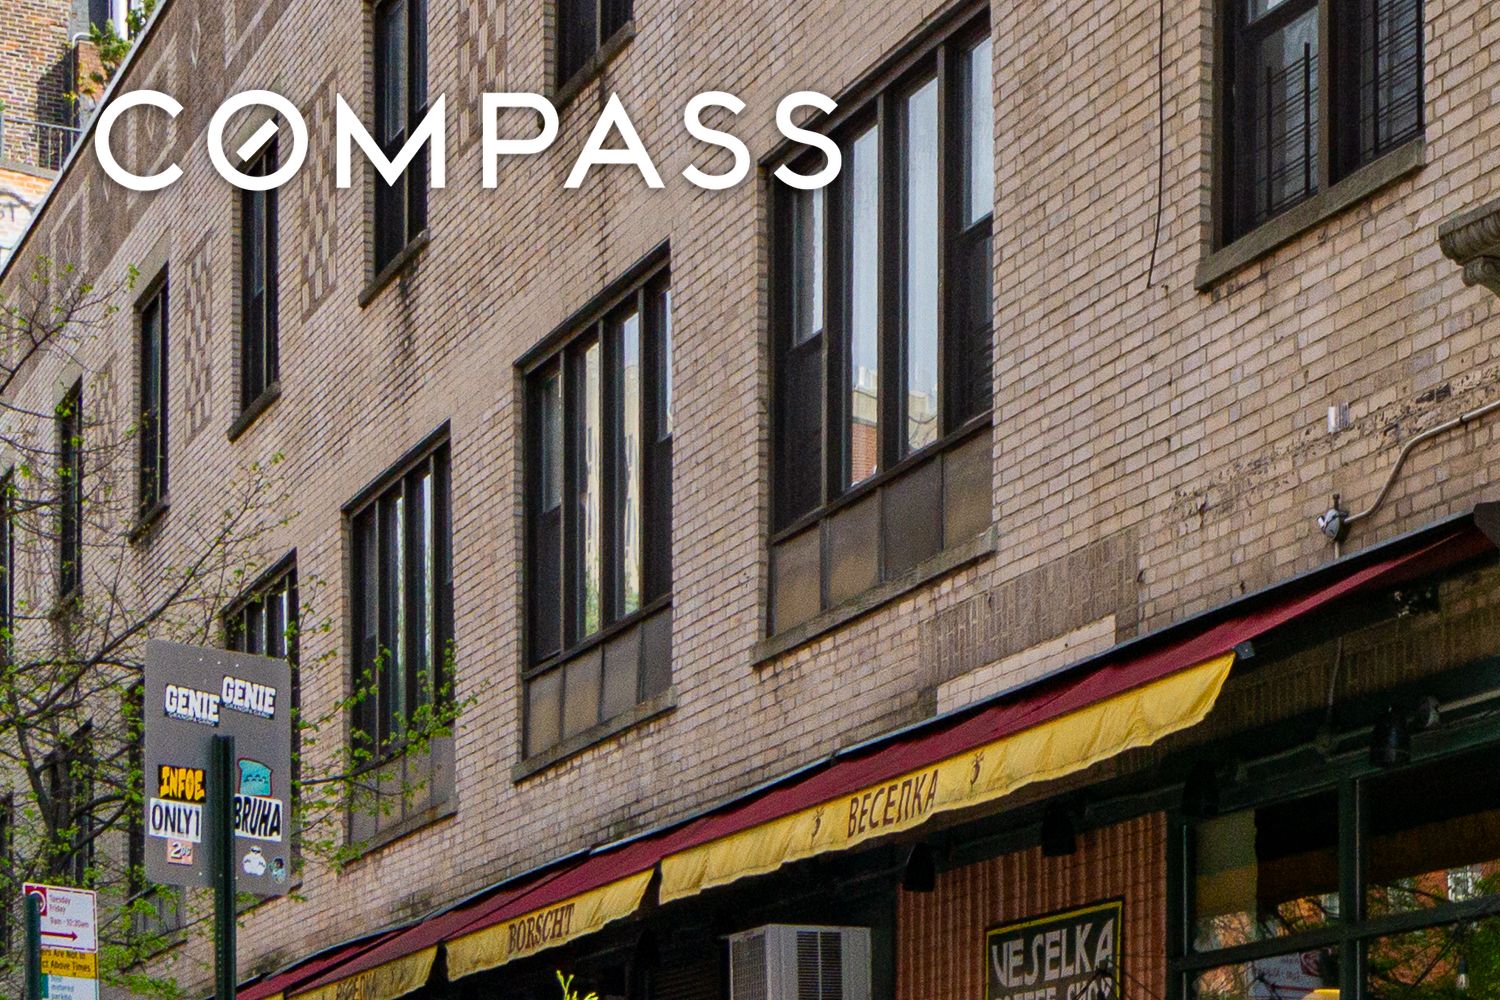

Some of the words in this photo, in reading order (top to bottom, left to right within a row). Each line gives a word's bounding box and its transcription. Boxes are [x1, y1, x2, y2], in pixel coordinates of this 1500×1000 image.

[165, 684, 220, 723] GENIE
[222, 676, 276, 715] GENIE
[234, 796, 281, 838] BRUHA
[49, 895, 71, 905] Tuesday
[508, 903, 575, 955] BORSCHT
[51, 960, 71, 970] Above
[72, 961, 91, 972] Times
[992, 918, 1114, 988] VESELKA
